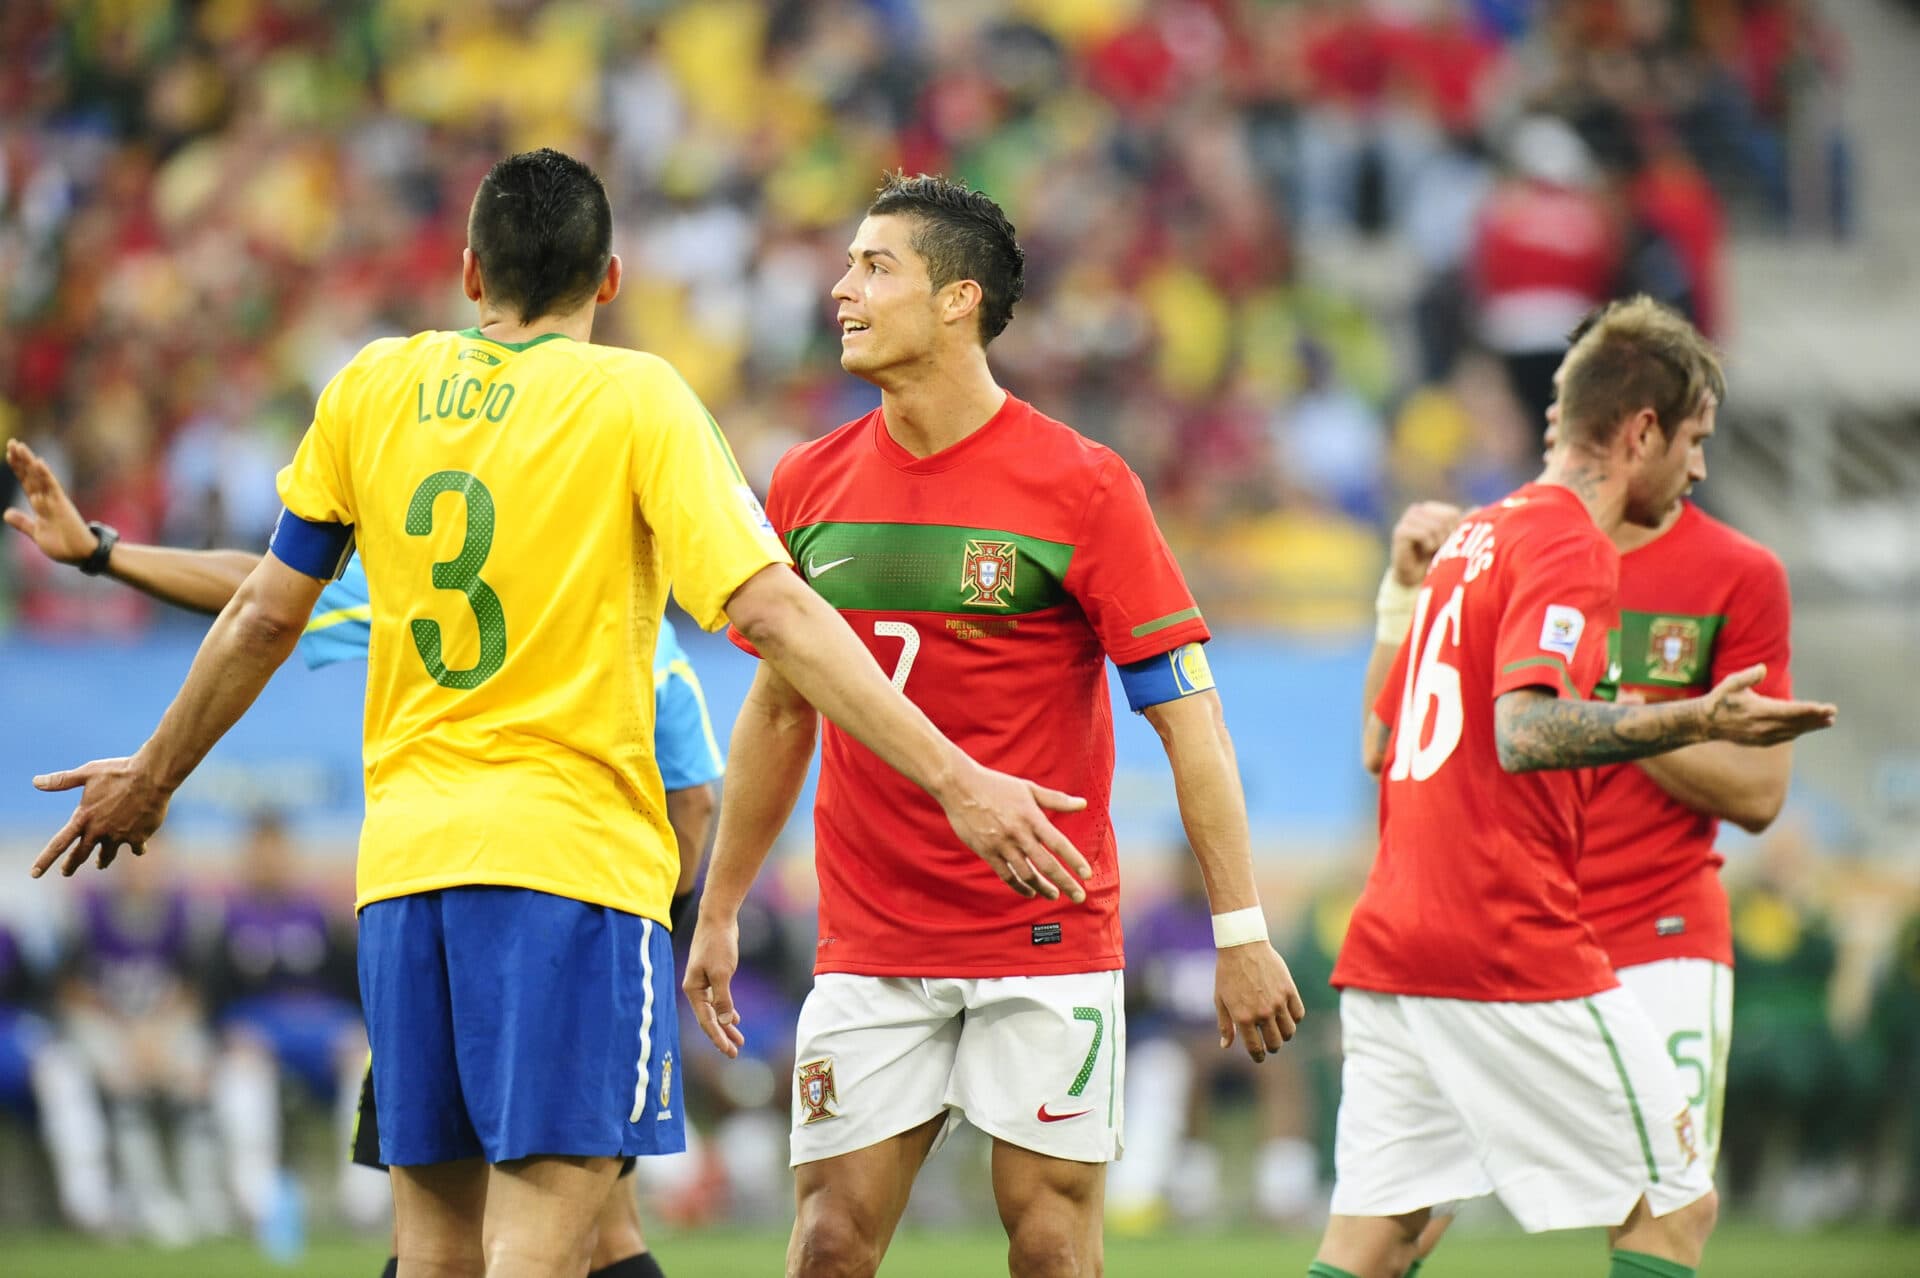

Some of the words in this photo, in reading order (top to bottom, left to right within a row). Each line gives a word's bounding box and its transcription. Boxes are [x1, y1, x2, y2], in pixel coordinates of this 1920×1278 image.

[418, 373, 515, 424] LÚCIO
[405, 470, 507, 690] 3
[874, 620, 921, 696] 7
[1389, 586, 1465, 782] 16
[1067, 1006, 1104, 1097] 7
[1667, 1030, 1705, 1107] 5
